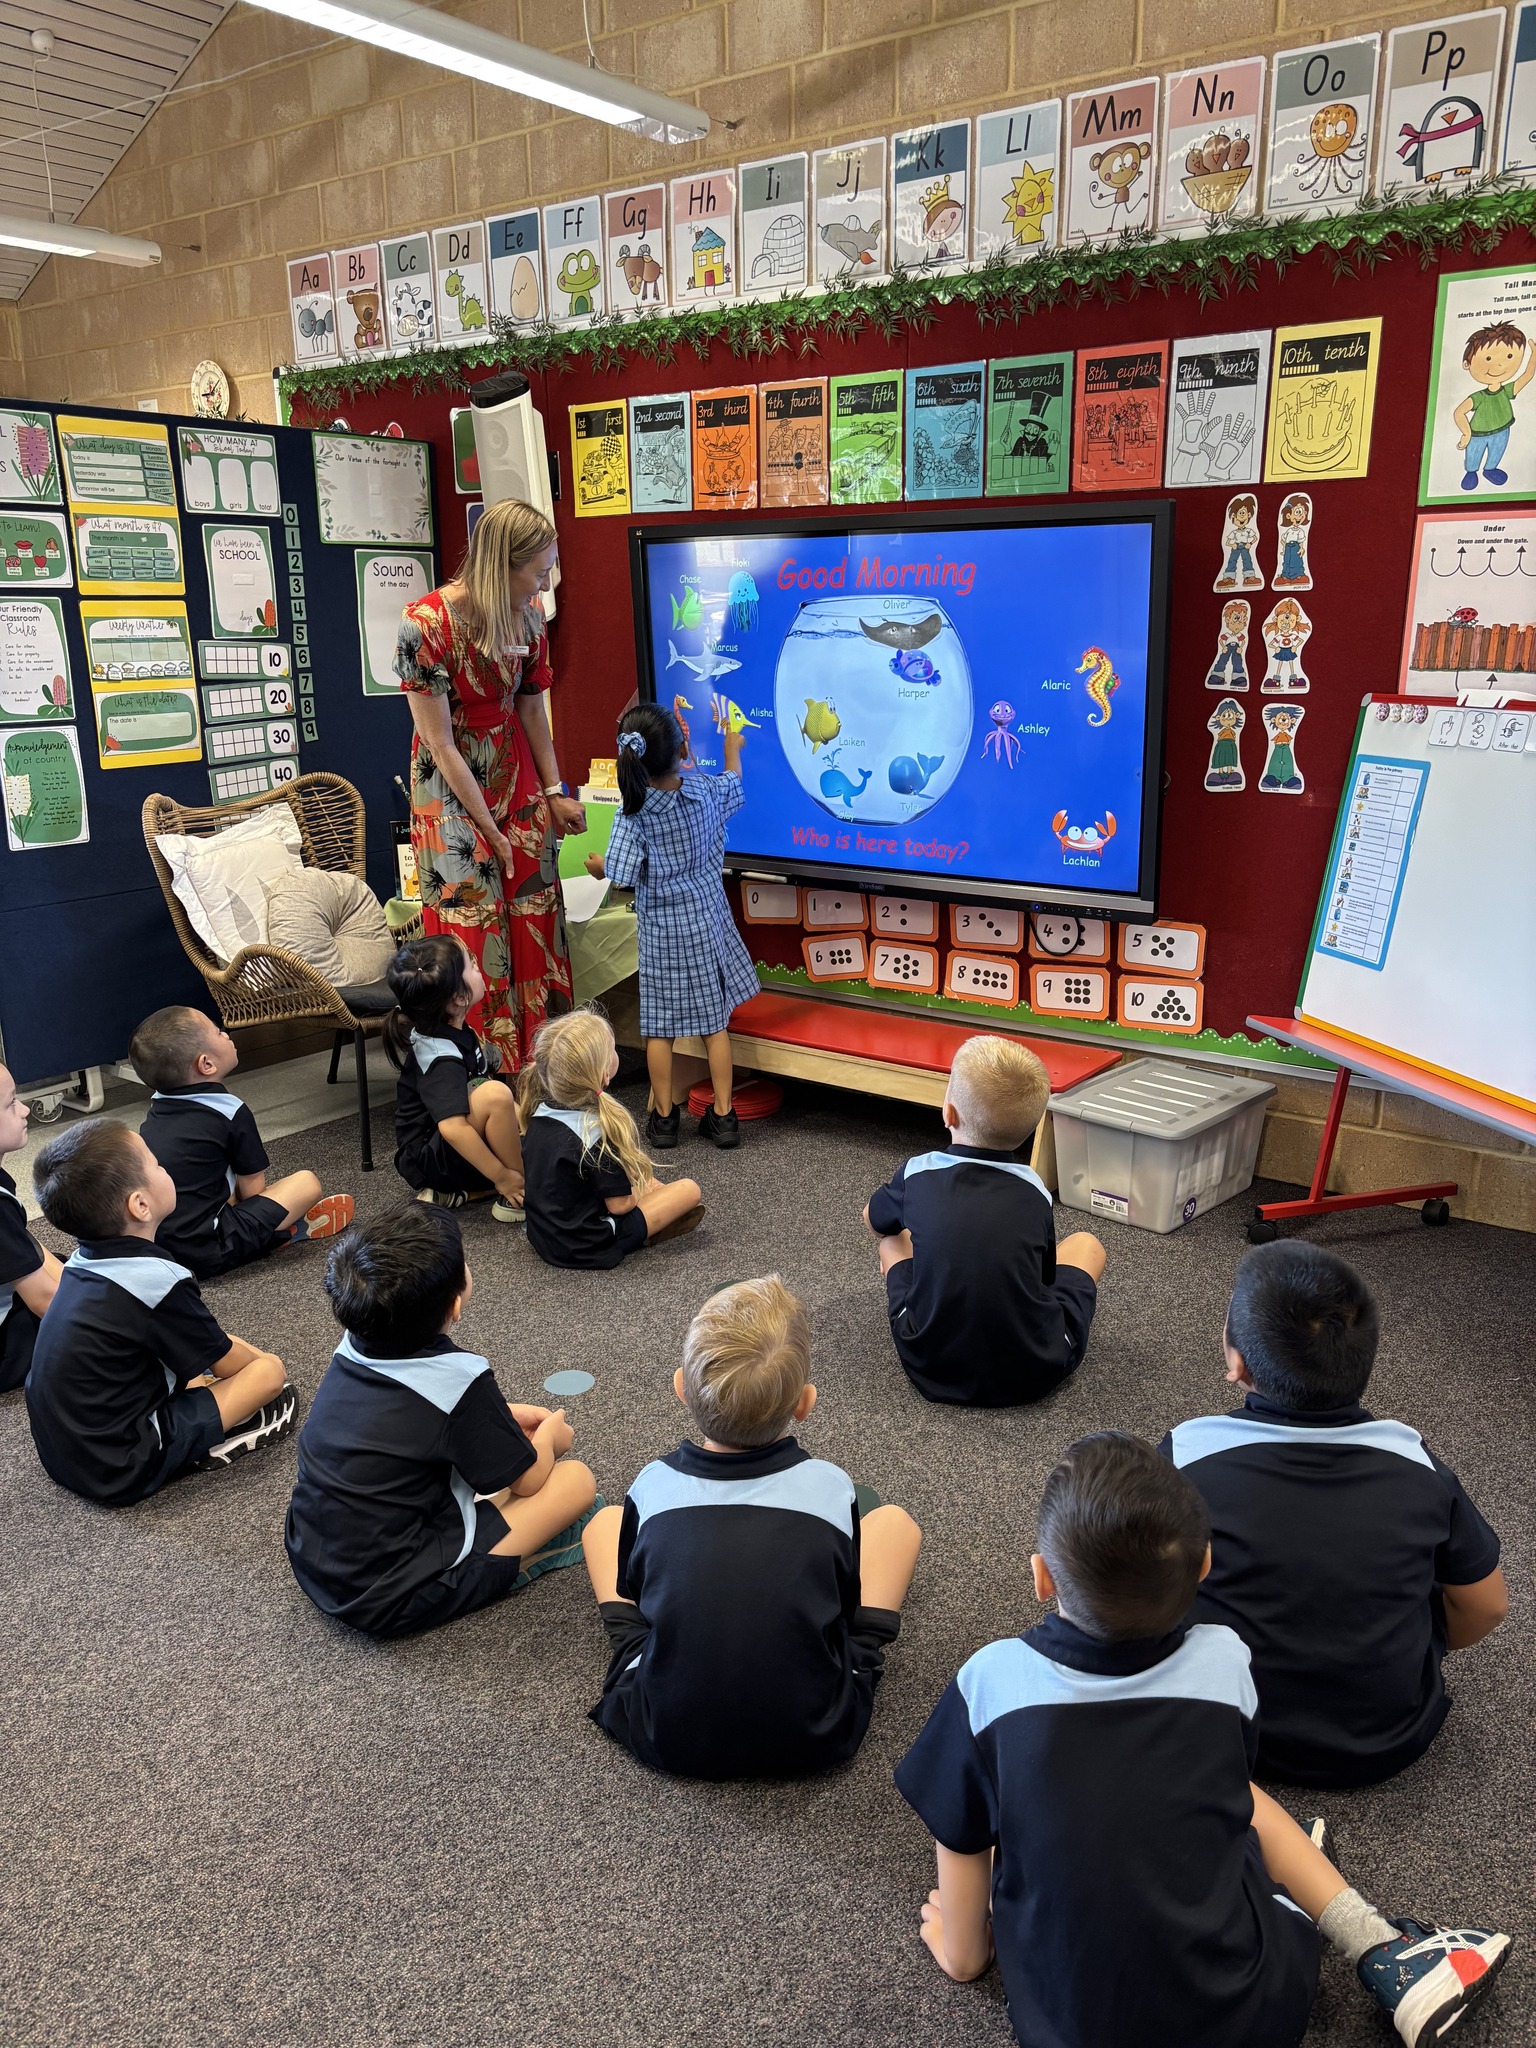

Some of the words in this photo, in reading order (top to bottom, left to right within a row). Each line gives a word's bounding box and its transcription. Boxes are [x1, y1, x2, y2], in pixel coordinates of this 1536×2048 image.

[1421, 30, 1466, 91] Pp
[1303, 54, 1345, 96] Oo
[1192, 74, 1235, 116] Nn
[1082, 95, 1142, 139] Mm
[1006, 114, 1031, 155] Ll
[916, 133, 945, 172] Kk
[765, 167, 781, 201] Ii
[836, 152, 861, 202] Jj
[688, 180, 716, 216] Hh
[563, 206, 585, 240] Ff
[622, 197, 647, 240] Gg
[504, 220, 524, 251] Ee
[449, 231, 470, 262] Dd
[397, 244, 417, 272] Cc
[348, 254, 366, 281] Bb
[300, 265, 320, 290] Aa
[1504, 281, 1519, 289] Tall
[1283, 346, 1313, 364] 10th
[1324, 337, 1367, 361] tenth
[1087, 364, 1109, 381] 8th
[1116, 357, 1159, 386] eighth
[1179, 361, 1201, 380] 9th
[1214, 358, 1256, 377] ninth
[995, 376, 1014, 391] 7th
[1017, 367, 1062, 389] seventh
[917, 382, 936, 397] 6th
[950, 378, 979, 394] sixth
[767, 396, 785, 409] 4th
[789, 392, 821, 414] fourth
[838, 391, 856, 406] 5th
[871, 385, 896, 410] fifth
[636, 407, 653, 424] 2nd
[655, 404, 684, 422] second
[698, 405, 714, 418] 3rd
[723, 403, 748, 417] third
[577, 417, 587, 429] 1st
[604, 411, 623, 433] first
[76, 437, 97, 451] What
[100, 435, 115, 457] day
[117, 444, 123, 453] is
[125, 442, 135, 454] it?
[204, 435, 223, 443] HOW
[226, 437, 247, 446] MANY
[335, 454, 345, 462] Our
[348, 455, 362, 463] Virtue
[383, 458, 401, 469] fortnight
[286, 508, 295, 522] 0
[90, 518, 112, 531] What
[114, 518, 143, 531] month
[144, 523, 151, 532] is
[152, 522, 162, 532] it?
[224, 537, 238, 547] have
[219, 549, 261, 560] SCHOOL
[291, 554, 300, 569] 2
[731, 557, 750, 567] Floki
[373, 562, 413, 577] Sound
[777, 557, 847, 589] Good
[855, 555, 977, 596] Morning
[293, 579, 301, 593] 3
[679, 574, 702, 584] Chase
[293, 602, 303, 617] 4
[883, 599, 911, 610] Oliver
[6, 622, 37, 637] Rules
[108, 620, 135, 635] Weekly
[135, 618, 164, 632] Weather
[296, 627, 304, 640] 5
[710, 641, 738, 652] Marcus
[269, 652, 281, 667] 10
[298, 649, 307, 664] 6
[302, 676, 309, 690] 7
[1041, 680, 1071, 691] Alaric
[114, 695, 134, 708] What
[136, 698, 142, 707] is
[142, 696, 158, 707] the
[159, 691, 178, 706] date?
[269, 689, 287, 705] 20
[898, 688, 930, 700] Harper
[304, 701, 312, 714] 8
[749, 707, 773, 719] Alisha
[273, 729, 290, 744] 30
[306, 722, 315, 738] 9
[1017, 723, 1050, 737] Ashley
[7, 739, 69, 754] Acknowledgement
[838, 737, 866, 748] Laiken
[696, 757, 717, 767] Lewis
[274, 766, 292, 782] 40
[593, 795, 613, 803] Equipped
[791, 826, 829, 849] Who
[836, 831, 851, 849] is
[856, 831, 898, 855] here
[904, 837, 969, 864] today?
[1063, 855, 1101, 868] Lachlan
[752, 891, 759, 905] 0
[813, 898, 817, 911] 1
[881, 906, 890, 918] 2
[962, 914, 970, 928] 3
[1043, 924, 1053, 938] 4
[1132, 934, 1142, 948] 5
[815, 950, 823, 963] 6
[880, 953, 888, 967] 7
[957, 965, 965, 978] 8
[1043, 980, 1052, 993] 9
[1131, 992, 1145, 1007] 10
[1185, 1203, 1194, 1215] 30
